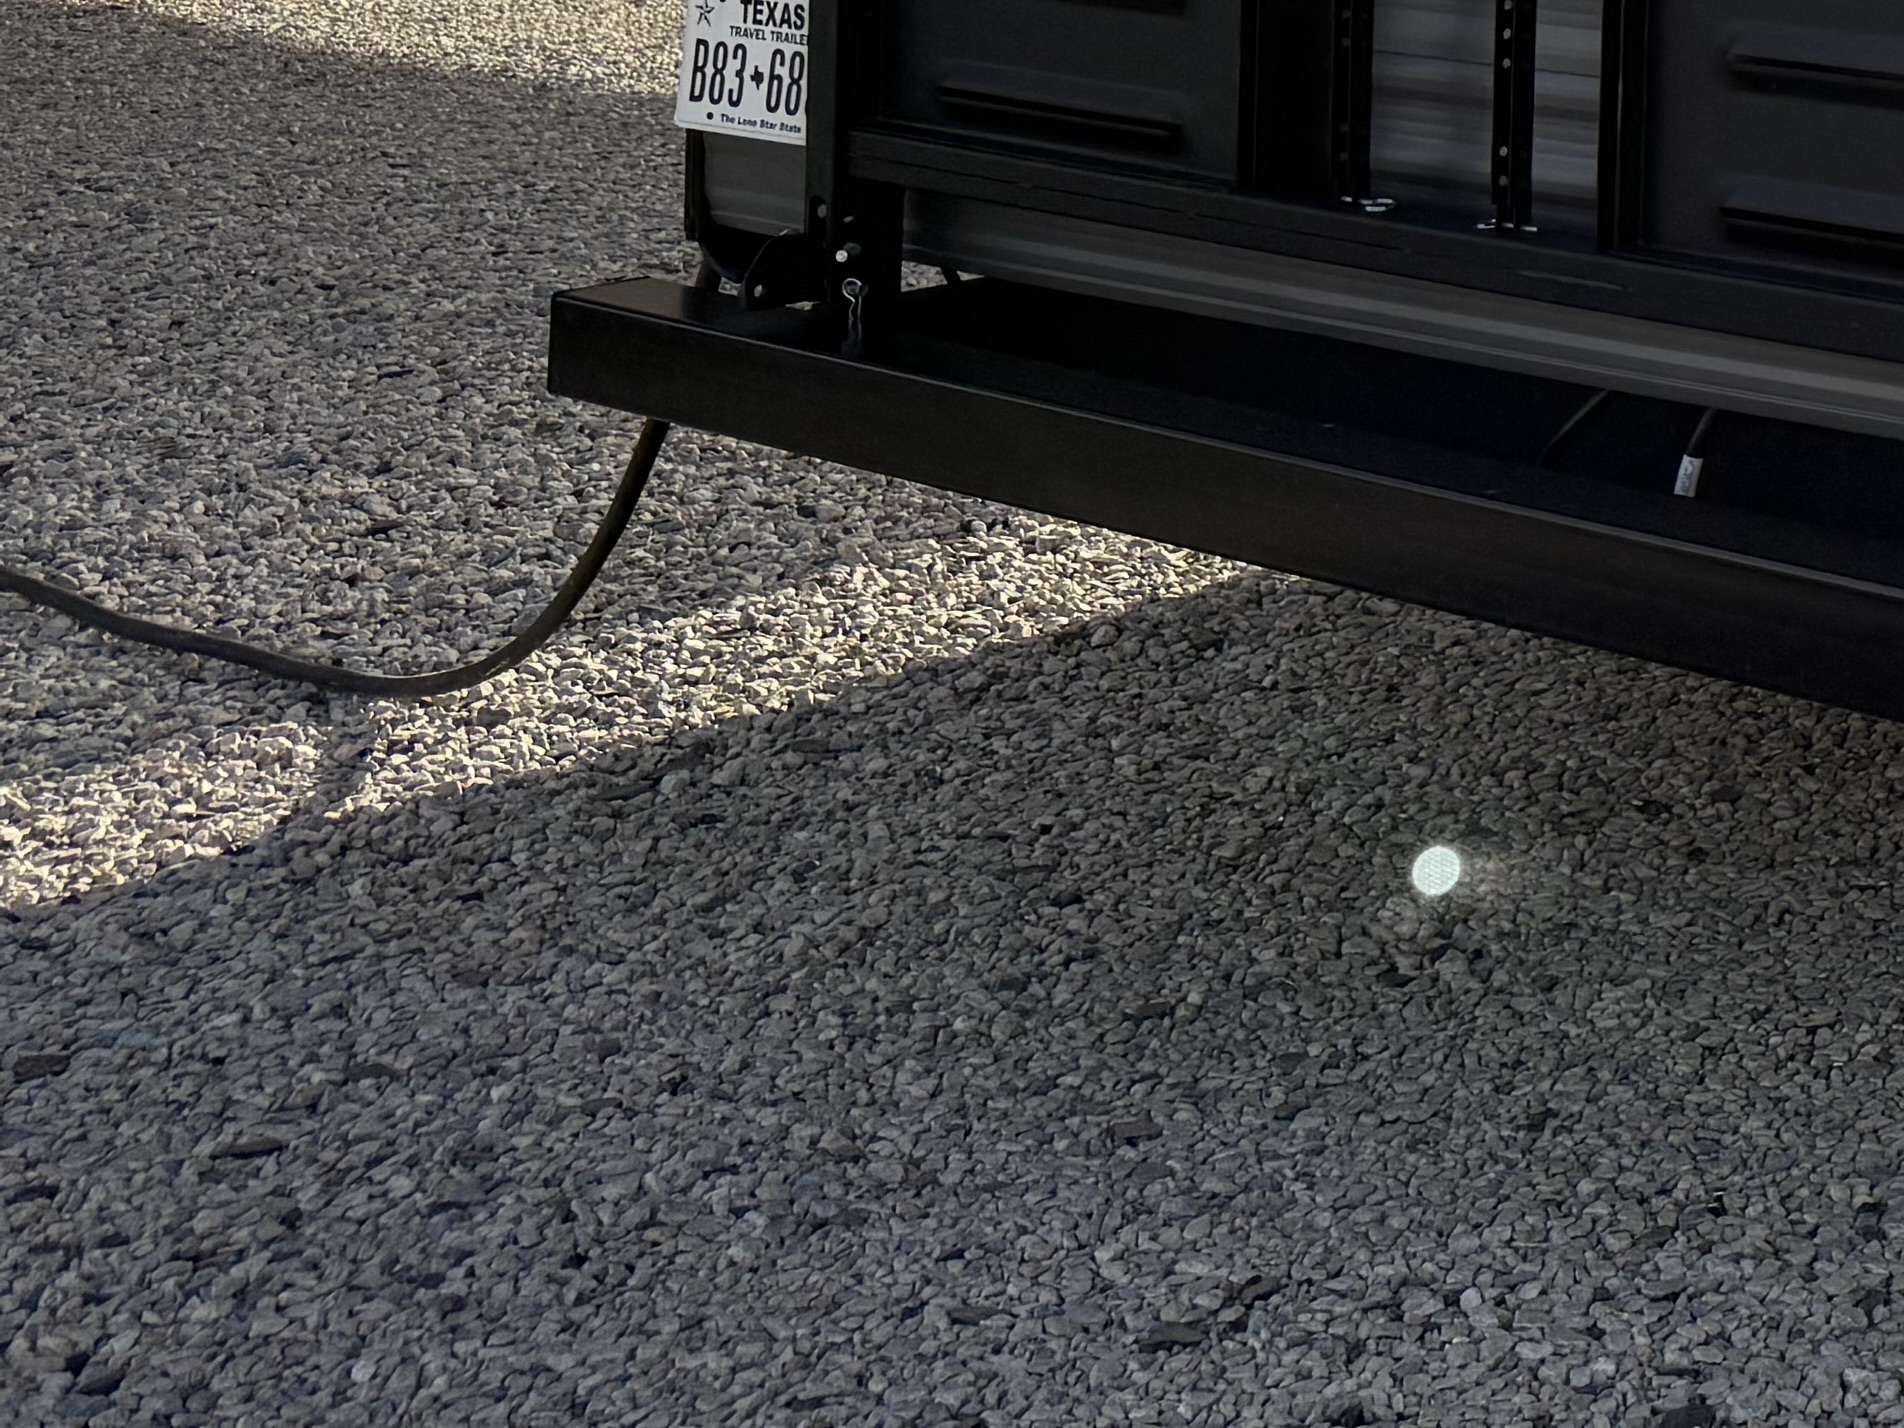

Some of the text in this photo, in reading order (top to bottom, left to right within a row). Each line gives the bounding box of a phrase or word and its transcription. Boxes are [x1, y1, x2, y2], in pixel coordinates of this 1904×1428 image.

[729, 25, 808, 46] TRAVEL TRAILE
[689, 37, 747, 108] B83
[720, 113, 802, 134] The Lone Star State
